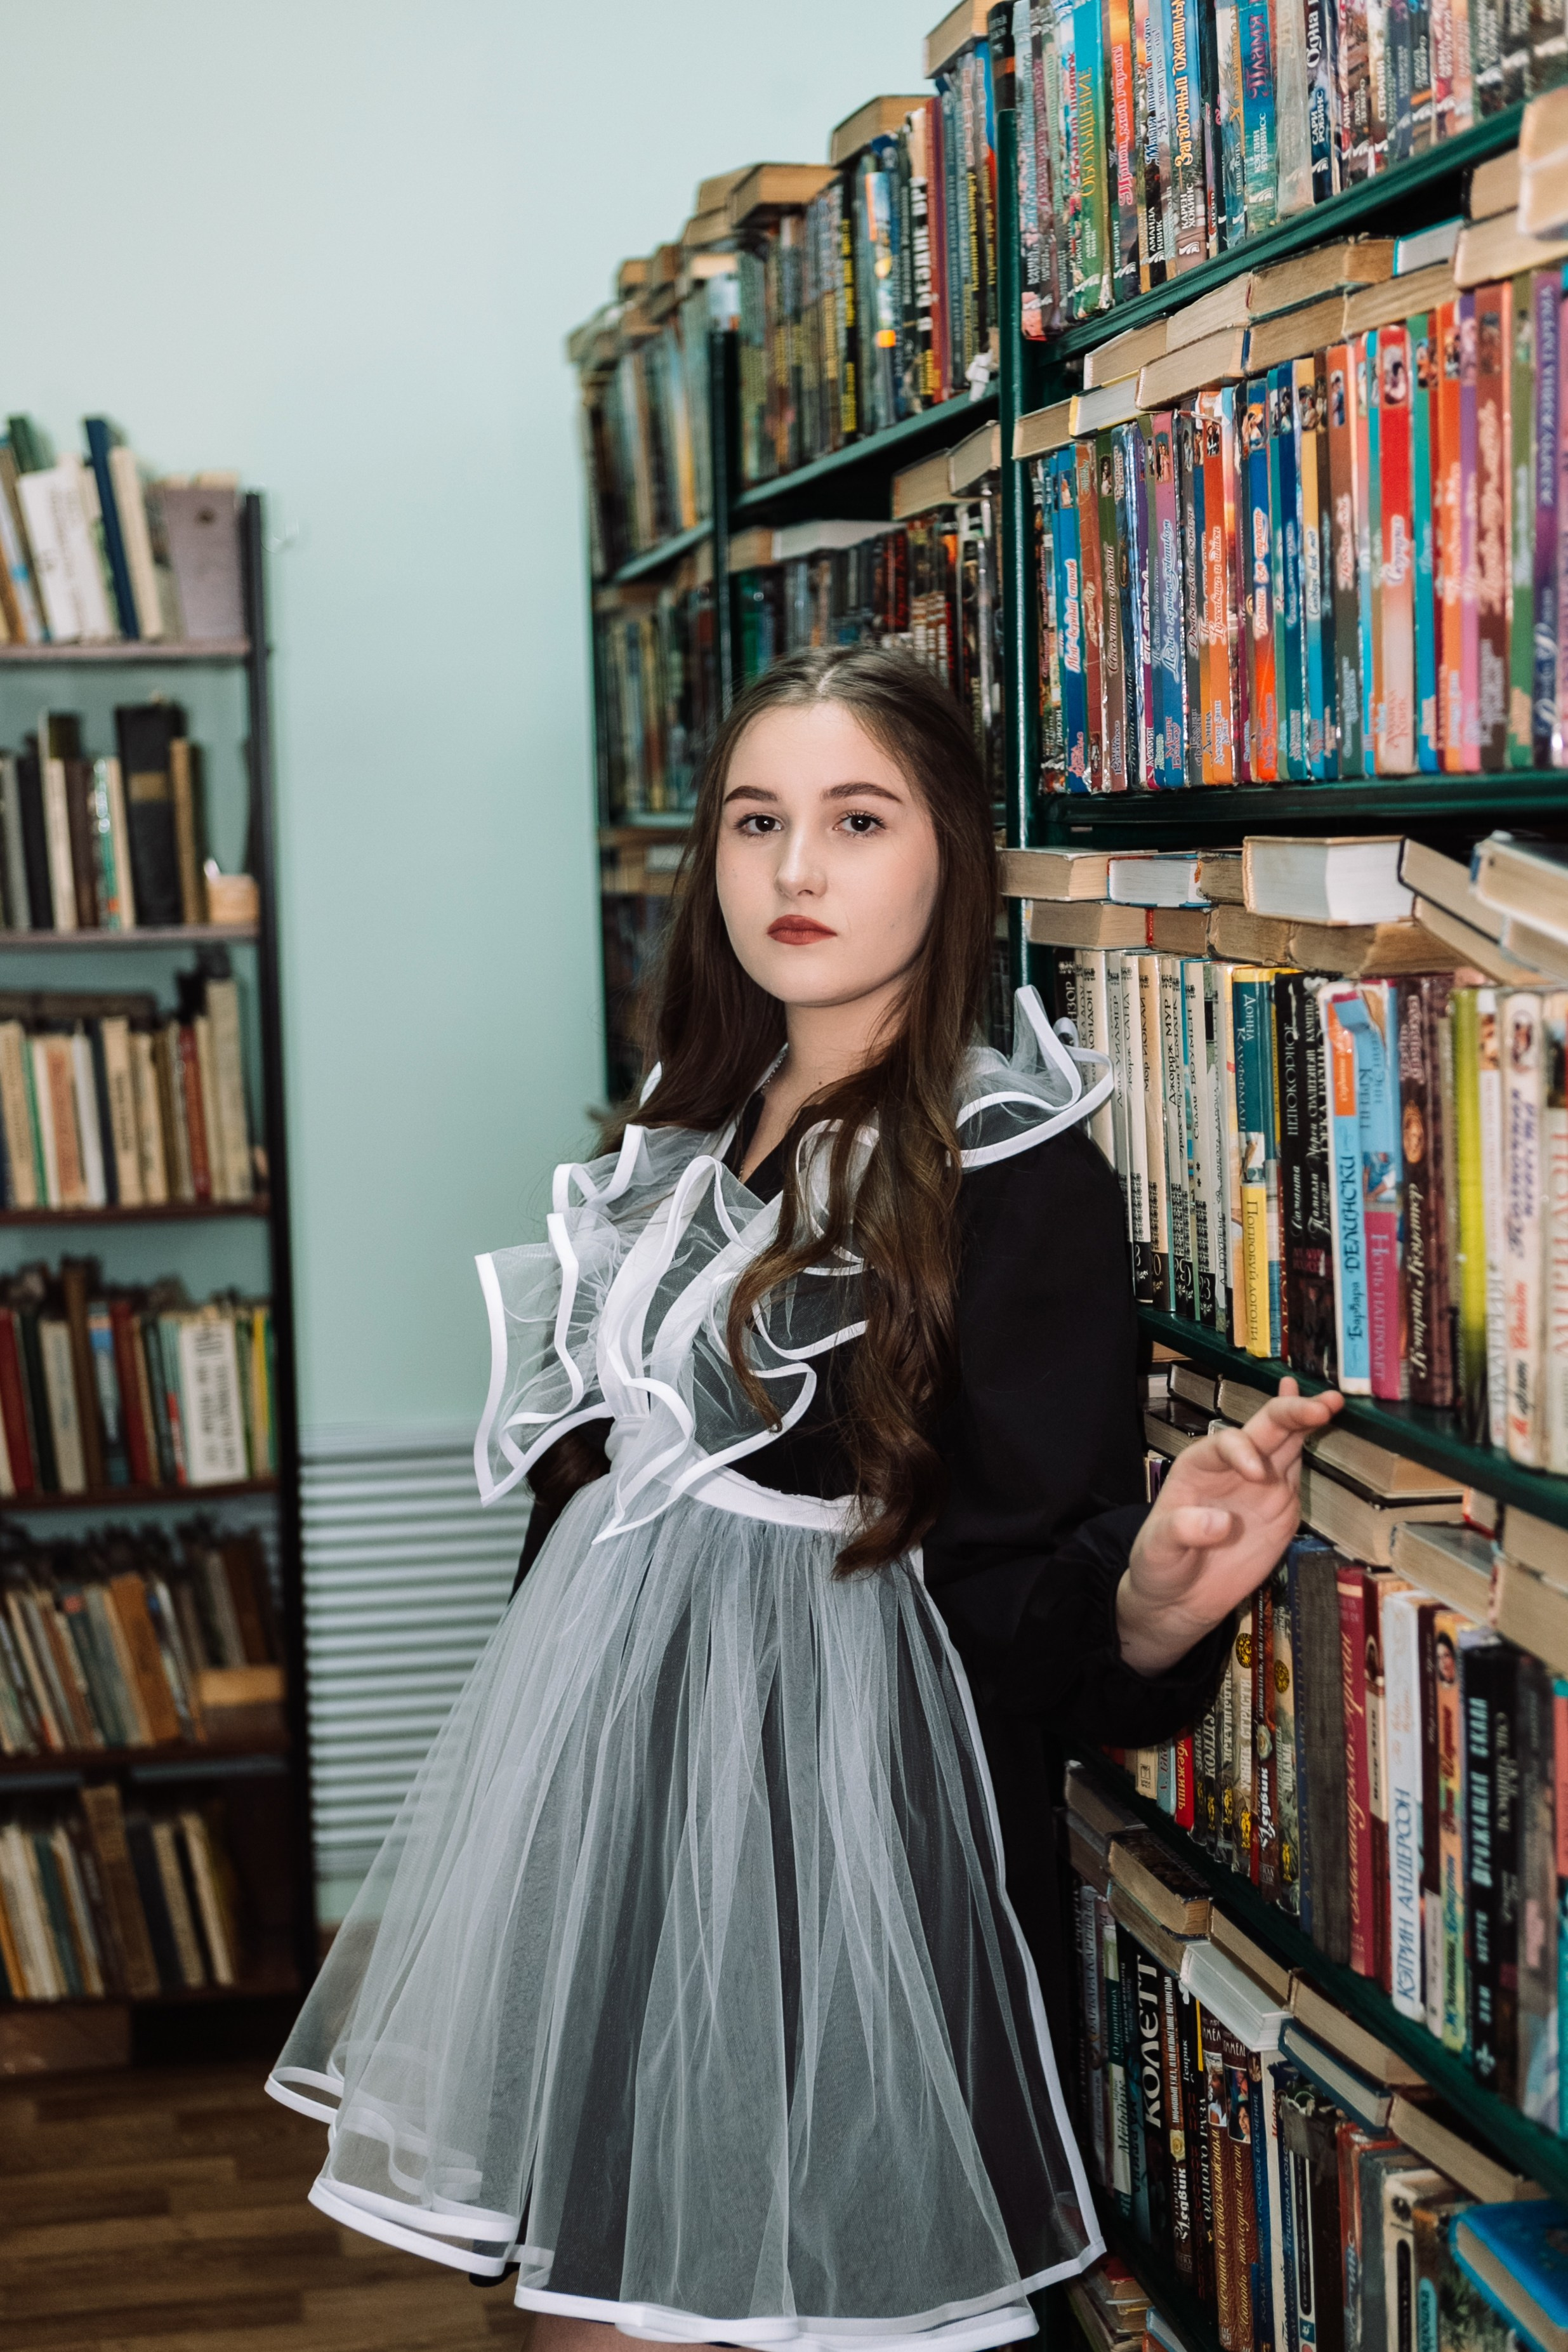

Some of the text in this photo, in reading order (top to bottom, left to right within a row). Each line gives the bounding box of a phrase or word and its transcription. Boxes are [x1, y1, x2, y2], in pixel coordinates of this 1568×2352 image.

[1246, 13, 1268, 100] Пламя
[1305, 10, 1322, 68] Одна
[1316, 89, 1326, 143] РОБИНС
[1376, 60, 1387, 122] СТЕФАНИ
[1078, 67, 1097, 196] ОБОЛЬЩЕНИЕ
[1155, 111, 1168, 135] На
[1174, 76, 1194, 167] Загадочный
[1252, 129, 1262, 174] КЭТЛИН
[1258, 112, 1267, 171] ВУДИВИСС
[1311, 110, 1319, 145] САРИ
[1147, 207, 1157, 252] АМАНДА
[1155, 220, 1164, 250] КВИК
[1180, 193, 1189, 230] КАРЕН
[1187, 183, 1196, 228] ХОКИНС
[1162, 519, 1178, 579] зонтиком
[1209, 527, 1221, 560] шпион
[1255, 510, 1266, 559] страсть
[1308, 554, 1317, 570] как
[1065, 559, 1077, 597] страж
[1164, 581, 1178, 623] черным
[1184, 505, 1199, 656] Дьявольский соблазн
[1209, 578, 1224, 638] Красавица
[1065, 600, 1077, 638] верный
[1104, 545, 1119, 673] Сведенные судьбой
[1161, 638, 1178, 674] Леди
[1055, 710, 1063, 746] ДЖОЗИ
[1146, 727, 1154, 767] ДЖУЛИЯ
[1086, 989, 1095, 1050] ЛОНДОН
[1113, 995, 1121, 1065] УИЛМЕР
[1187, 1008, 1196, 1085] БОУМЕН
[1243, 994, 1256, 1041] ДОННА
[1126, 1048, 1134, 1092] Жорж
[1166, 1044, 1176, 1106] Джордж
[1237, 1027, 1247, 1130] КАУФФМАН
[1283, 1022, 1298, 1135] НЕПОКОРНОЕ
[1302, 998, 1317, 1118] СВАДЕБНЫЙ КАМЕНЬ
[1246, 1201, 1258, 1341] ПОПРОБУЙ ДОГОНИ
[1340, 1154, 1364, 1340] Барбара ДЕЛИНСКИ
[1370, 1234, 1390, 1288] НОЧЬ
[1199, 1274, 1211, 1300] 23
[1406, 1182, 1428, 1378] Кэтрин Коултер
[1238, 1675, 1253, 1791] УЗНИК СТРАСТИ
[1469, 1696, 1489, 1758] СКАЛА
[1282, 1741, 1293, 1792] ПЛАМЯ
[1394, 1785, 1414, 1910] АНДЕРСОН
[1397, 1916, 1416, 2001] КЭТРИН
[1136, 1954, 1162, 2129] КОЛЕТТ
[1164, 1976, 1180, 2123] ЛЮБОВНЫЙ УЗЕЛ, ИЛИ ИСПЫТАНИЕ ВЕРНОСТЬЮ
[1182, 2039, 1191, 2082] Генрик
[1251, 2092, 1262, 2154] ВЛЕЧЕНИЕ
[1199, 2096, 1212, 2221] ОДНОГО РАЗА
[1210, 2128, 1227, 2238] невозможном
[1255, 2158, 1263, 2214] РОКОВОЕ
[1215, 2240, 1225, 2249] о
[1234, 2144, 1252, 2341] Любовь последний мост
[1283, 2188, 1293, 2249] ГРЕШНАЯ
